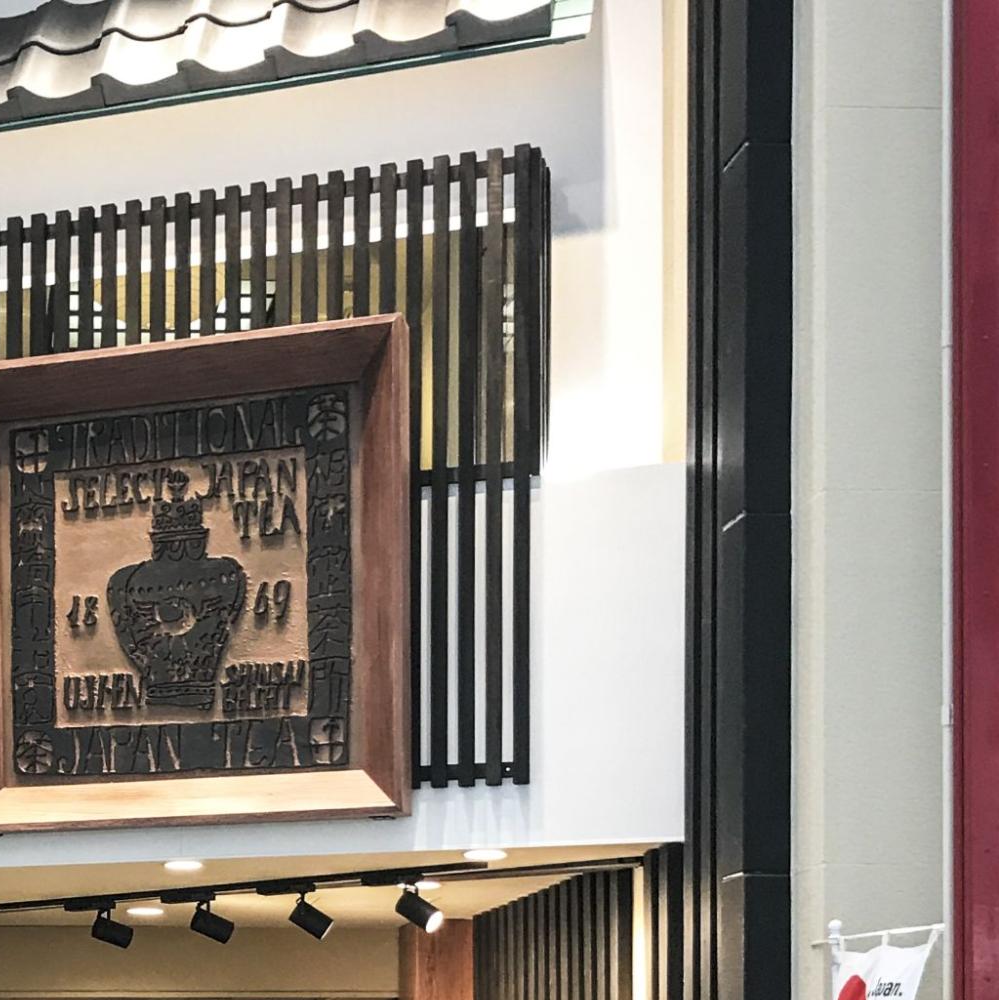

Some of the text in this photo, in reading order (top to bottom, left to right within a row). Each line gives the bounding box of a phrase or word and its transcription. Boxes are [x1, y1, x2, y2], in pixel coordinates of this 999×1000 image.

[57, 398, 302, 469] TRADITIONAL
[196, 457, 299, 499] JAPAN
[233, 495, 301, 540] TEA
[66, 580, 292, 628] 18 69
[57, 716, 301, 775] JAPAN TEA
